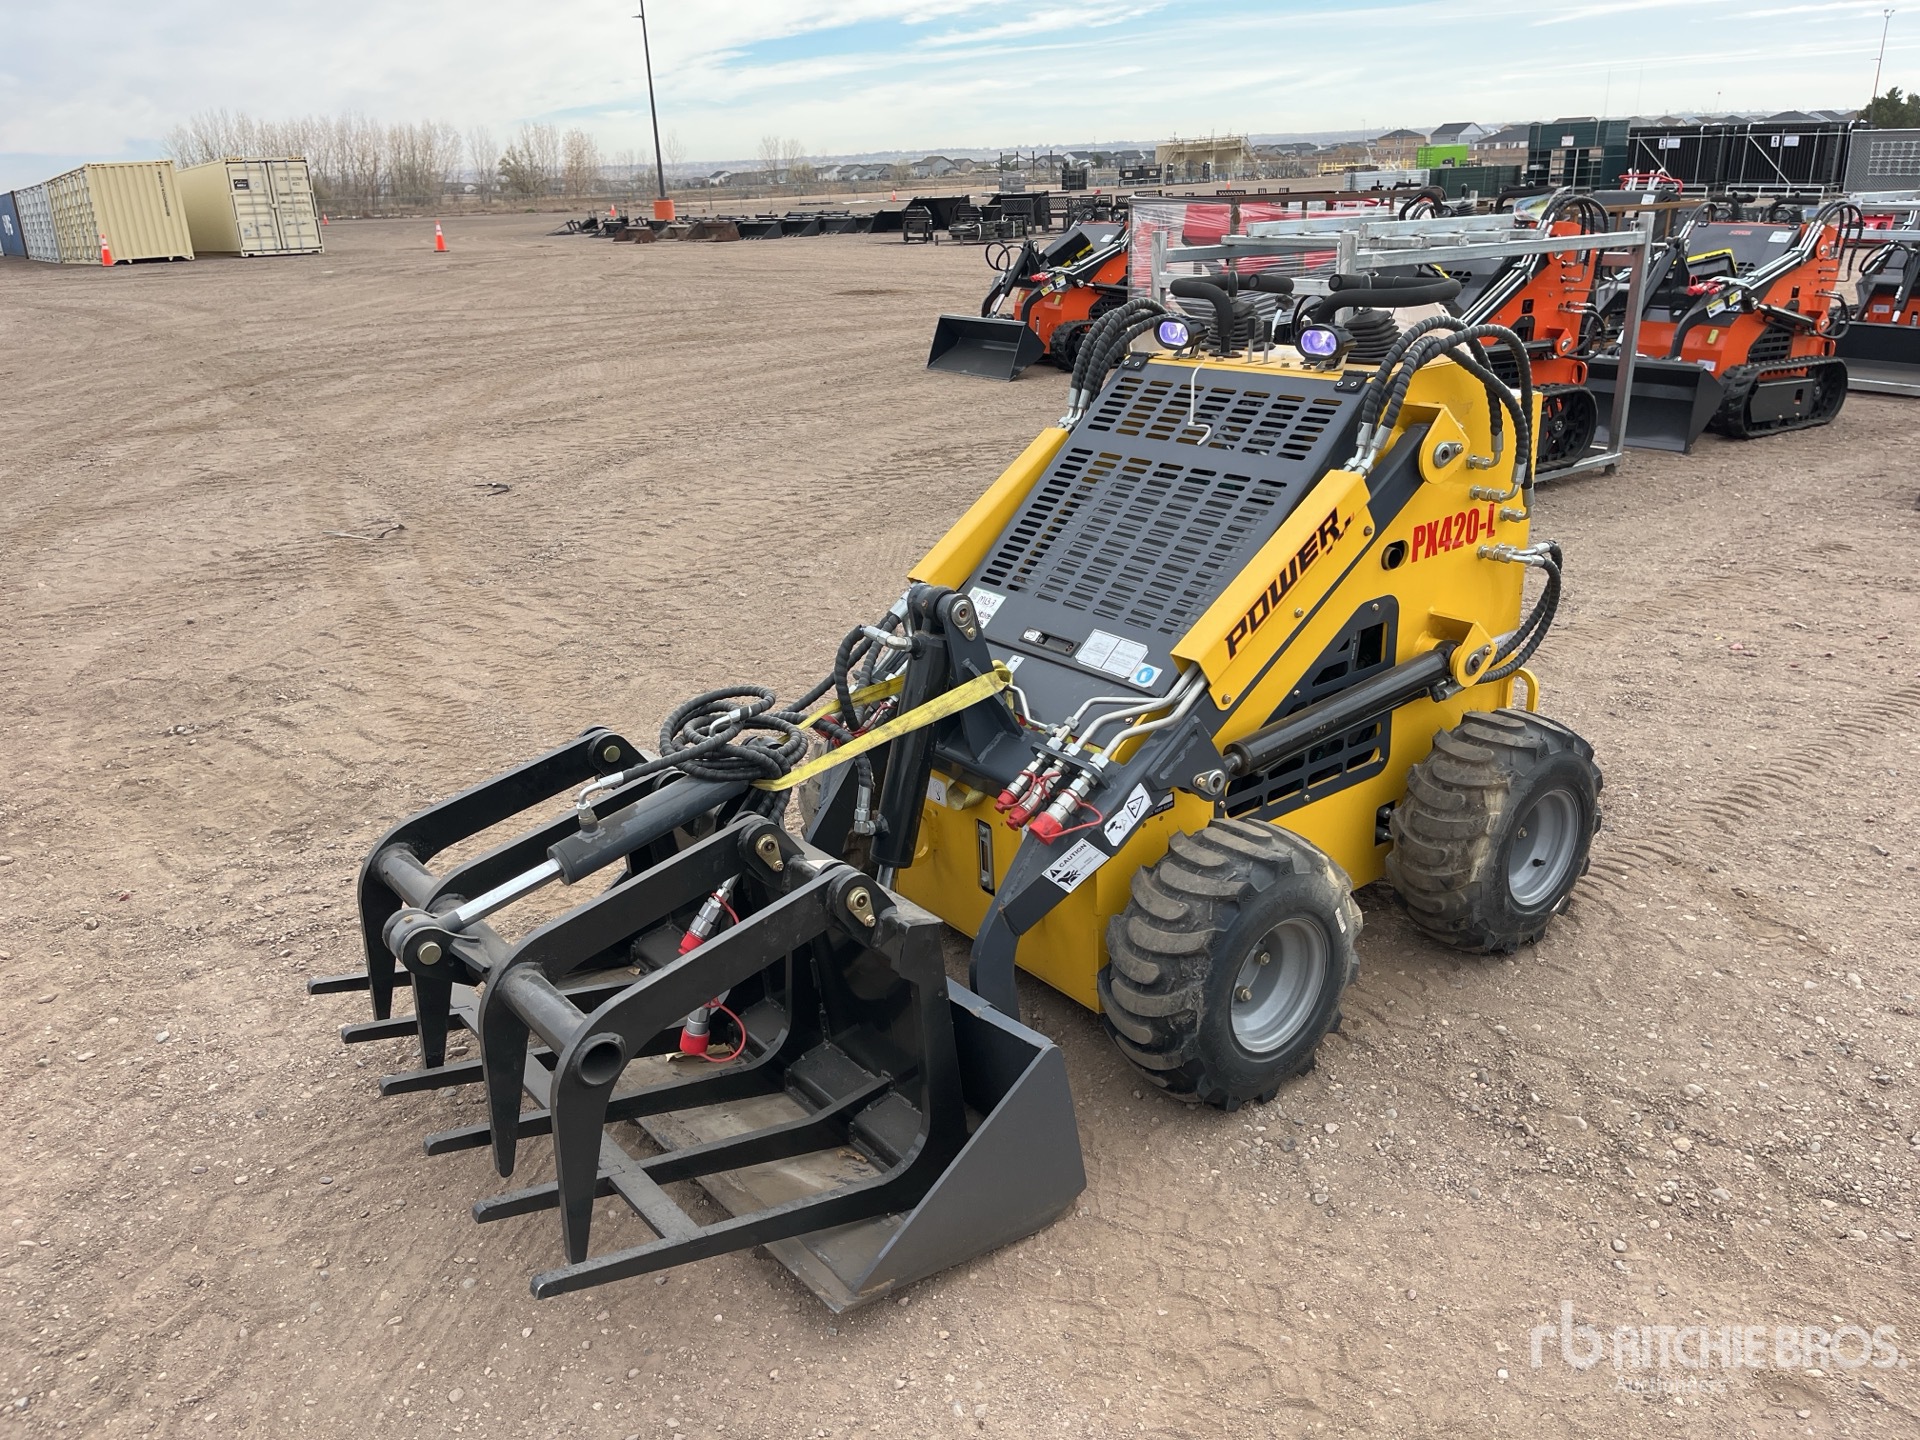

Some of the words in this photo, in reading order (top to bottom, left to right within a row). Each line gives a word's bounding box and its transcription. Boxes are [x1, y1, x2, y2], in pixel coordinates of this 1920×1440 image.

[1411, 503, 1496, 563] PX420-L
[1223, 506, 1340, 660] POWER
[1059, 843, 1087, 868] CAUTION
